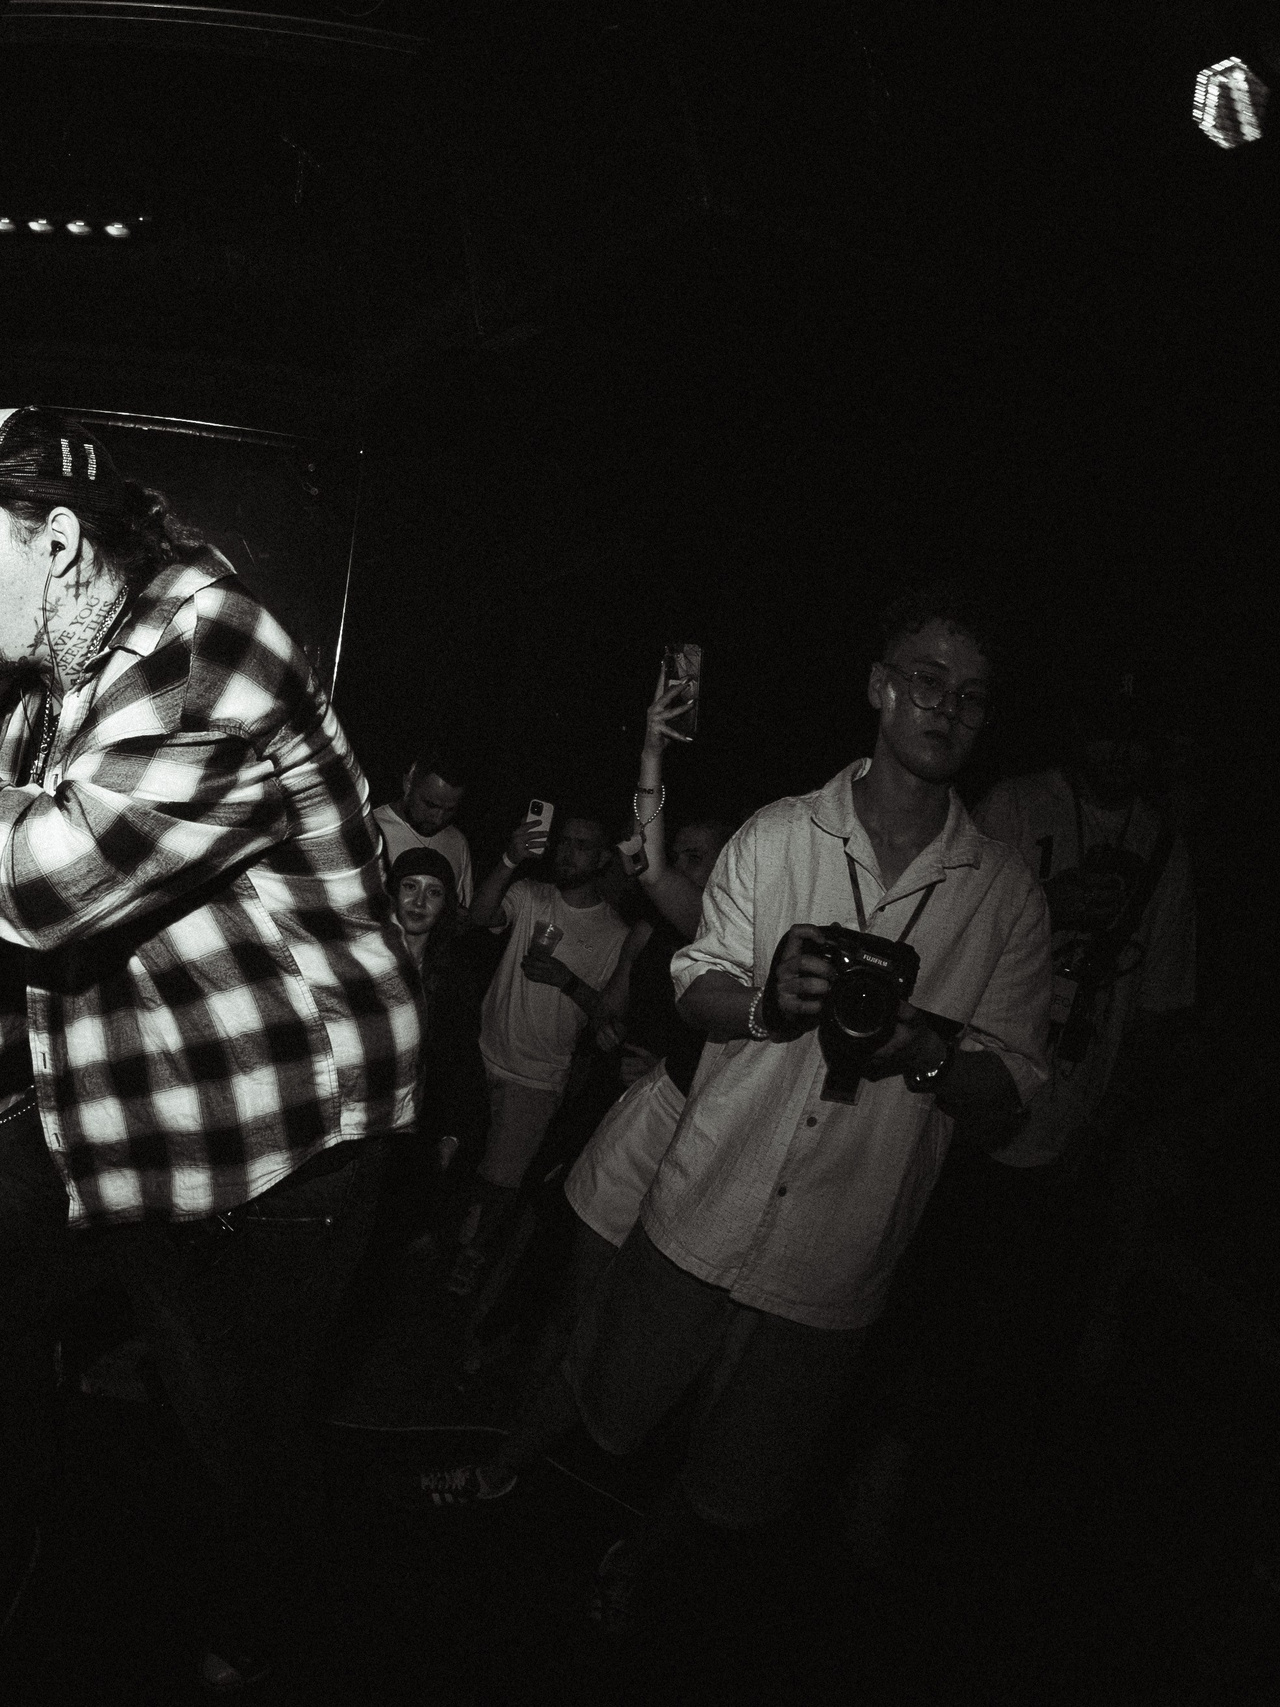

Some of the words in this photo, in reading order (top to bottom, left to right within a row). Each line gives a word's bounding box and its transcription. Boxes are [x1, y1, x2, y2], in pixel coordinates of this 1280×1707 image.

[44, 630, 75, 664] HAVE
[69, 595, 100, 626] YOU
[58, 637, 88, 671] SEEN
[83, 601, 114, 632] THIS
[863, 954, 888, 967] FUJIFILM
